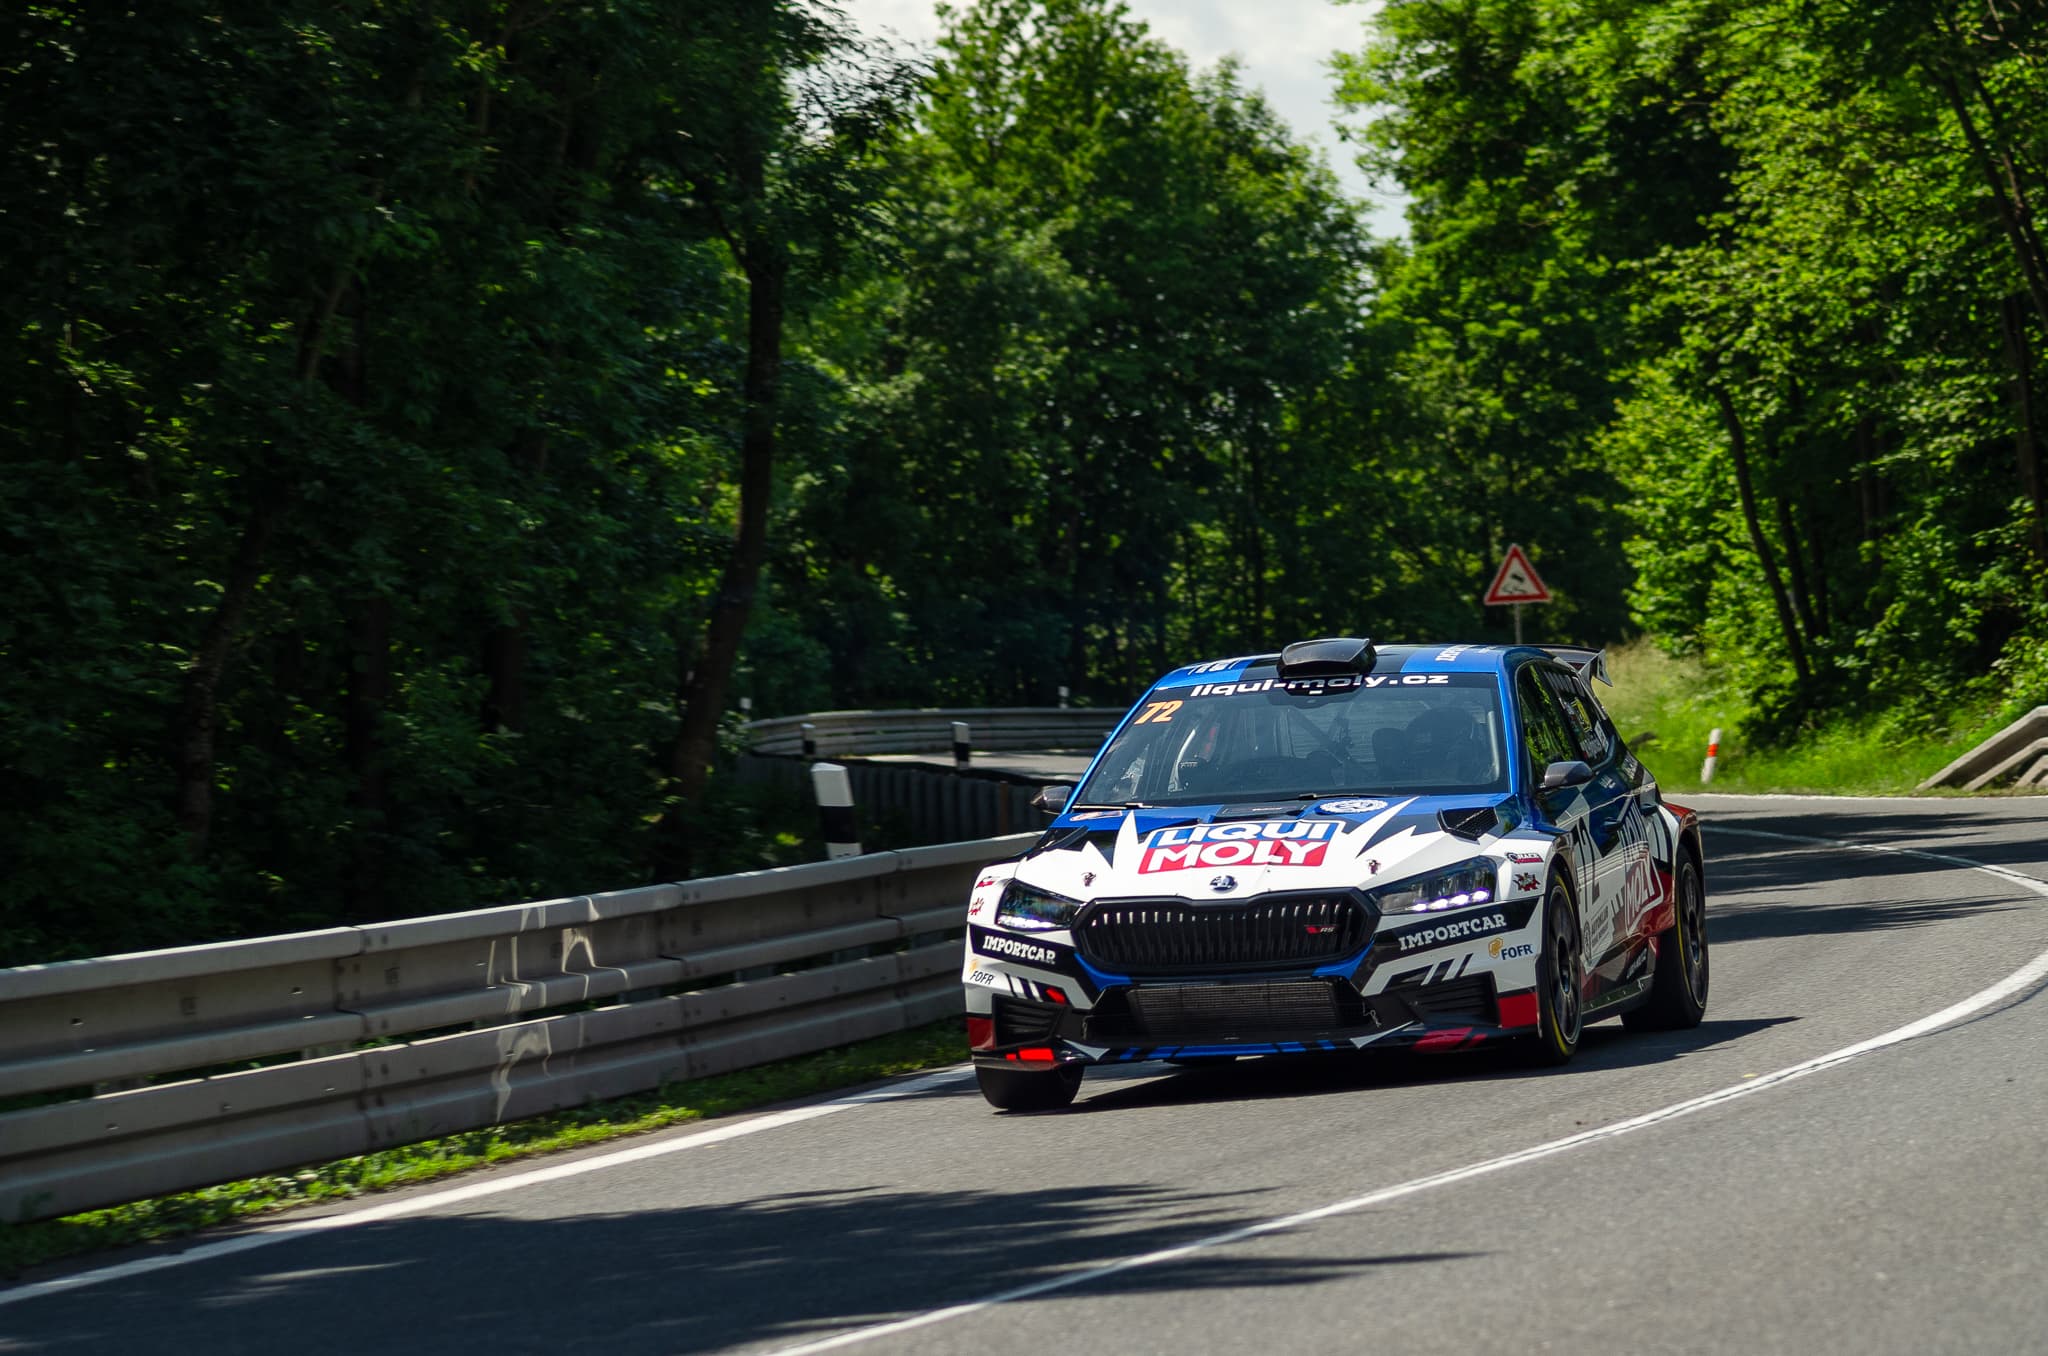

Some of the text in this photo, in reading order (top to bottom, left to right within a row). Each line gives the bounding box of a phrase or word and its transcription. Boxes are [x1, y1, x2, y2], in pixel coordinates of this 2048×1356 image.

[1190, 674, 1449, 697] liqui-moly.cz
[1134, 700, 1184, 725] 72
[1158, 821, 1328, 847] LIQUI
[1149, 840, 1320, 869] MOLY
[1626, 852, 1655, 926] MOLY
[1399, 913, 1507, 951] IMPORTCAR
[982, 934, 1056, 965] IMPORTCAR
[1501, 944, 1534, 960] FOFR
[969, 970, 994, 985] FOFR
